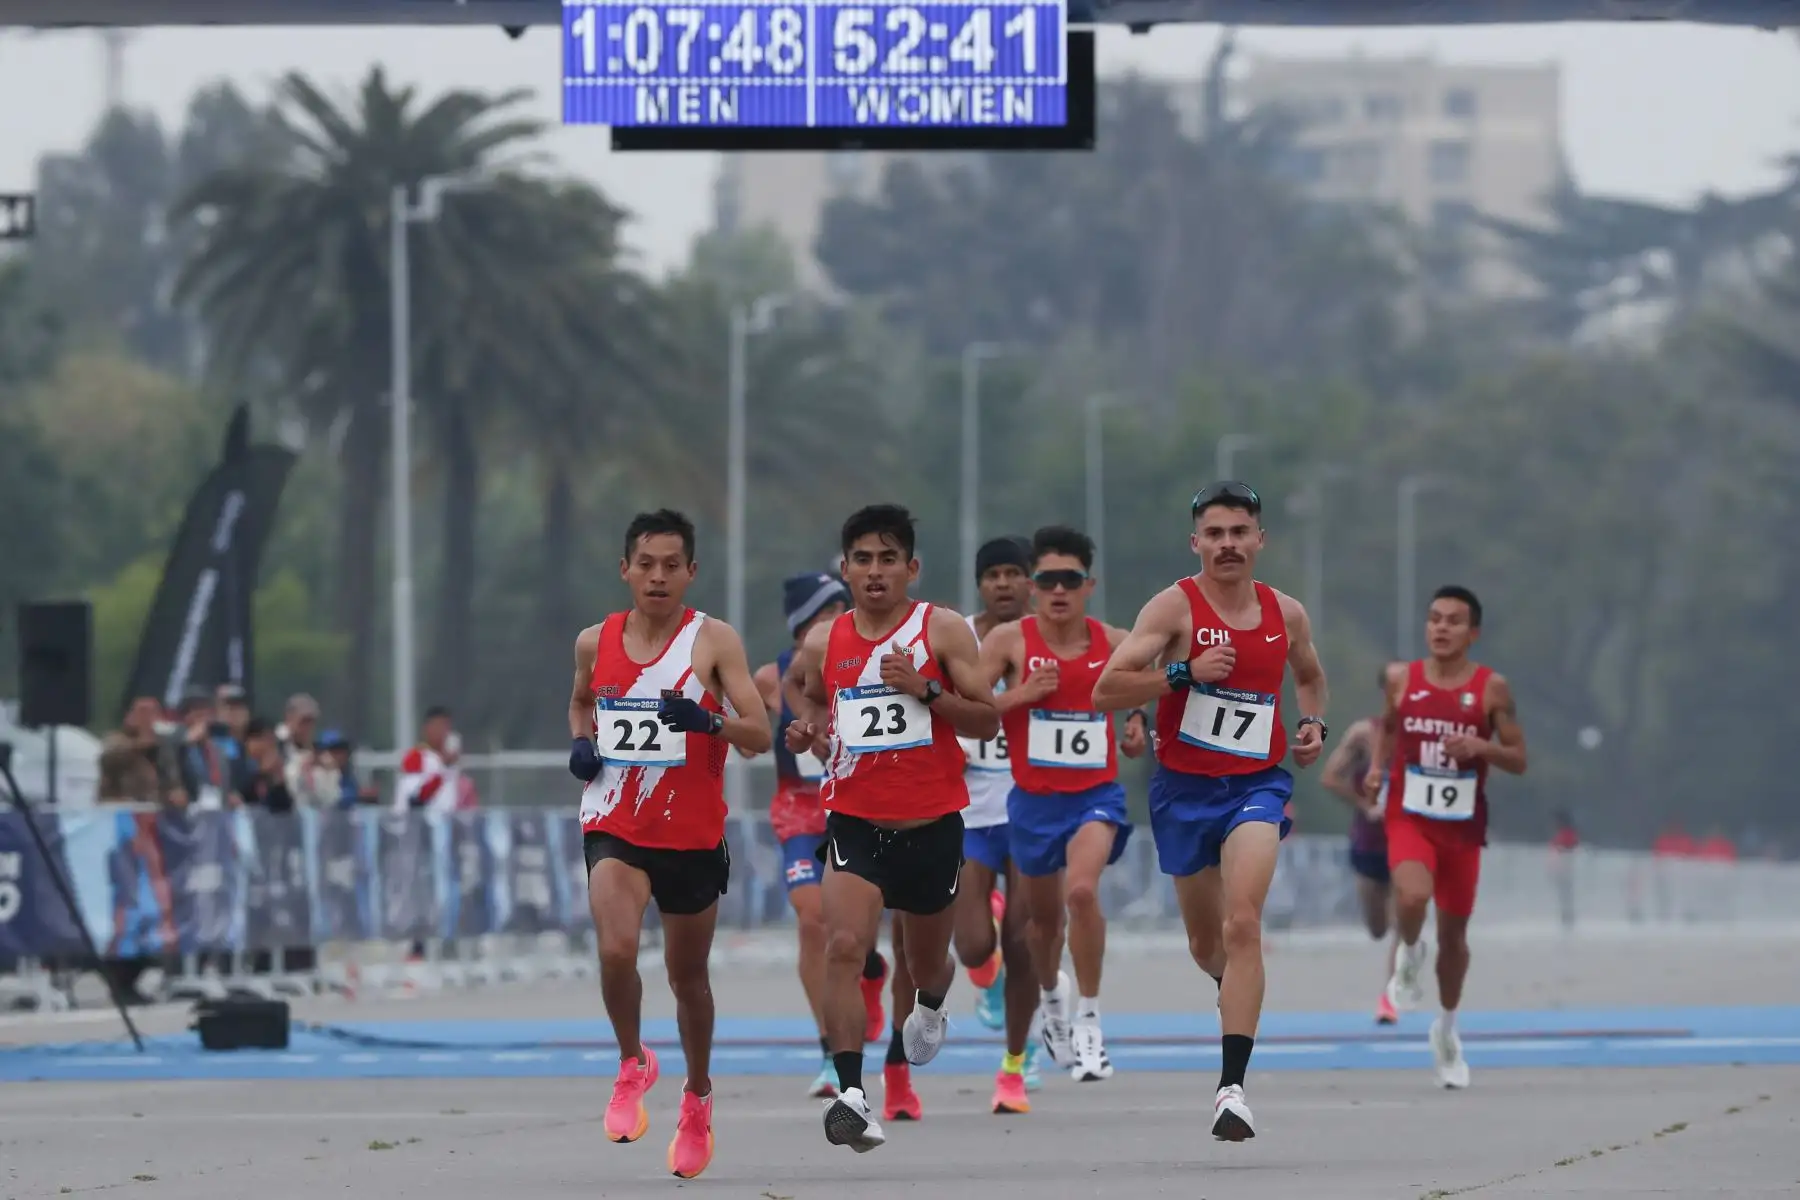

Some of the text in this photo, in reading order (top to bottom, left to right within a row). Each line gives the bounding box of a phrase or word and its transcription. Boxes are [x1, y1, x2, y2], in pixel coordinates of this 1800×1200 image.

[571, 7, 803, 74] 1:07:48
[833, 7, 1037, 74] 52:41
[636, 85, 738, 124] MEN
[847, 85, 1034, 124] WOMEN
[613, 719, 661, 751] 22
[860, 703, 907, 738] 23
[1211, 706, 1257, 741] 17
[1404, 716, 1478, 738] CASTILLO
[980, 736, 1009, 760] 15
[1055, 728, 1090, 755] 16
[1426, 783, 1458, 808] 19
